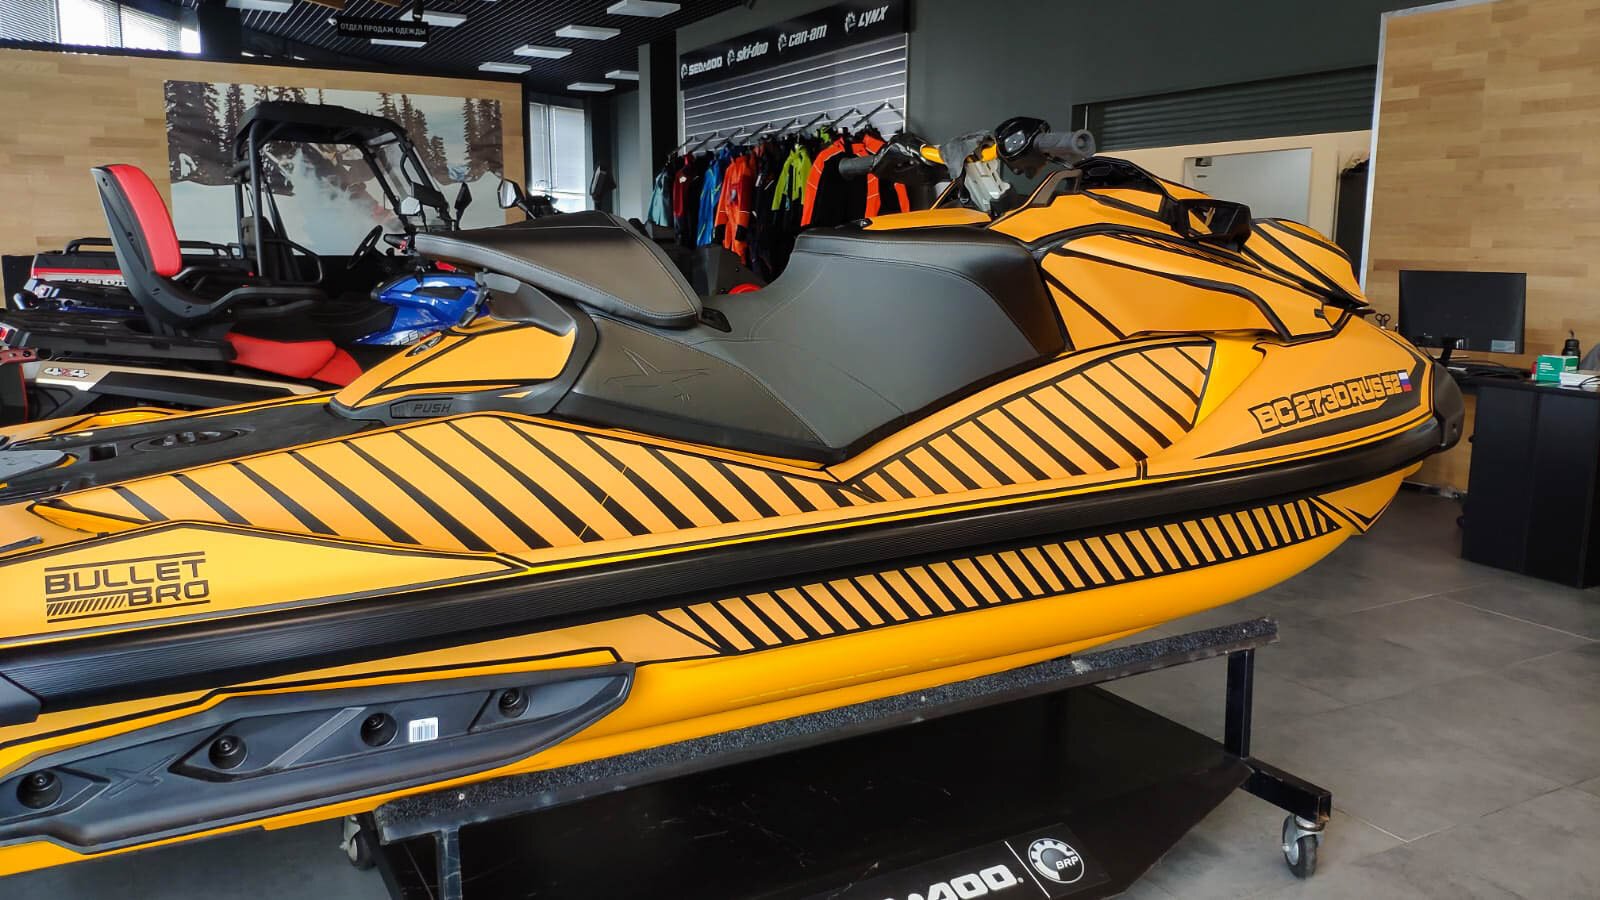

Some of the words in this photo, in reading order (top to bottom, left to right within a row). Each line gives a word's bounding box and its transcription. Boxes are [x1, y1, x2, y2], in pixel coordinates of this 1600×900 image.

[857, 6, 889, 27] LYNX
[340, 23, 363, 31] ОТДЕЛ
[364, 24, 394, 34] ПРОДАЖ
[395, 27, 427, 35] ОДЕЖДЫ
[788, 24, 828, 47] can-am
[736, 41, 769, 62] ski-doo
[412, 403, 452, 414] PUSH
[44, 558, 207, 595] BULLET
[127, 579, 210, 607] BRO
[1055, 856, 1079, 870] BRP
